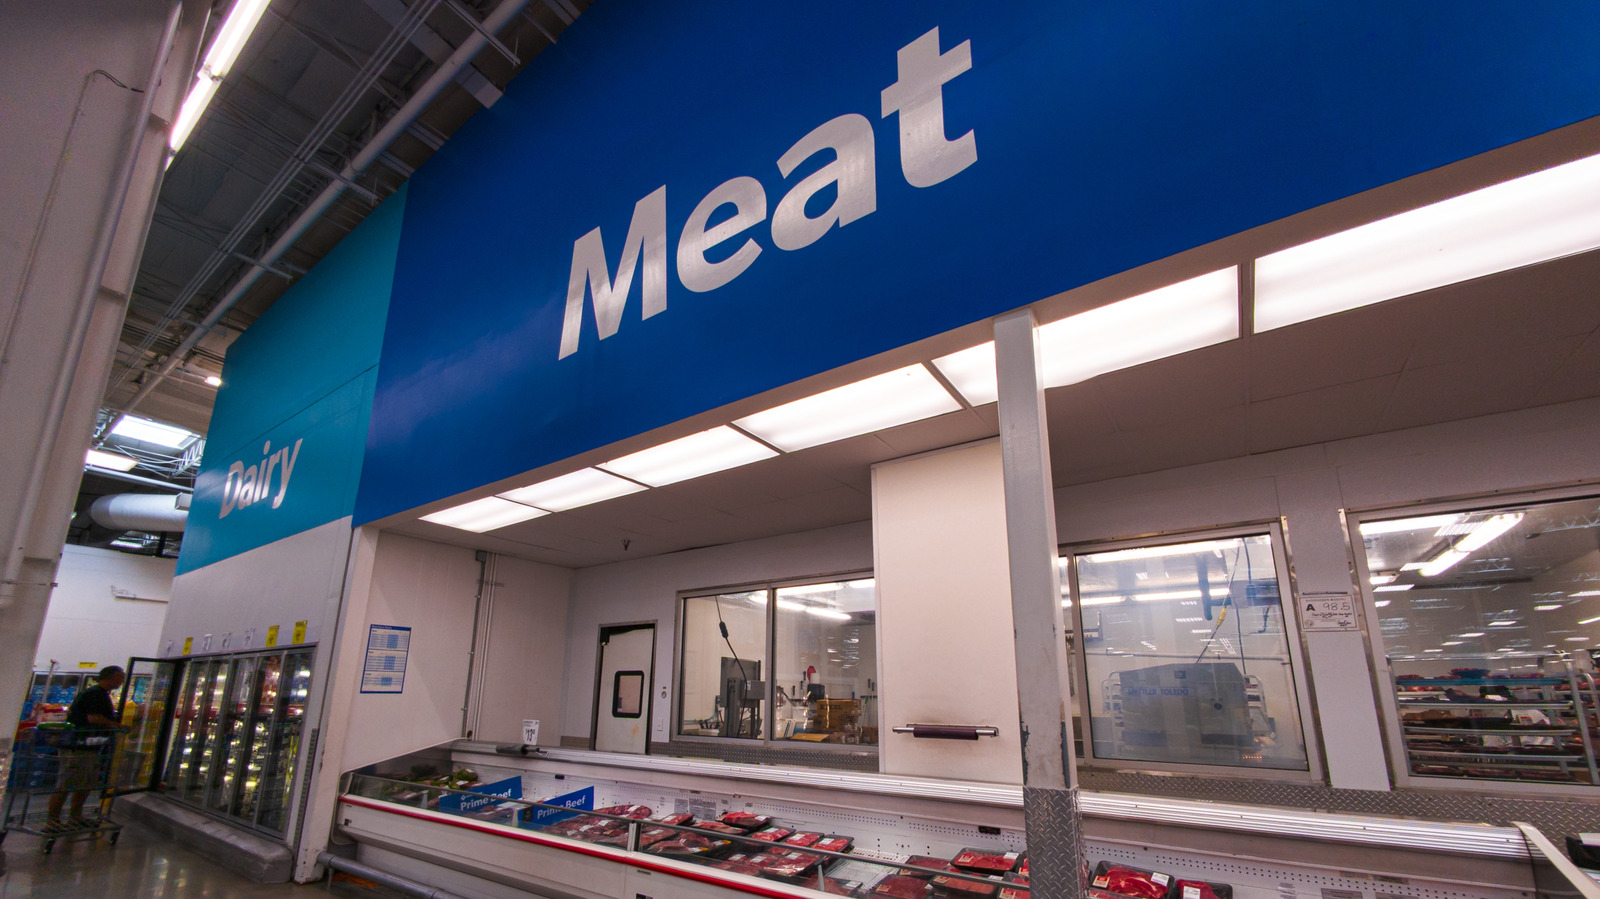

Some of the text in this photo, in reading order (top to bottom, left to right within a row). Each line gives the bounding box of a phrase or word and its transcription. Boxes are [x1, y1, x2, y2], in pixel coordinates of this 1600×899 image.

[558, 25, 978, 360] Meat
[219, 438, 303, 519] Dairy
[1306, 602, 1351, 611] A 98.5
[1161, 687, 1189, 696] TOLEDO
[460, 797, 489, 811] Prime
[565, 794, 586, 809] Beef
